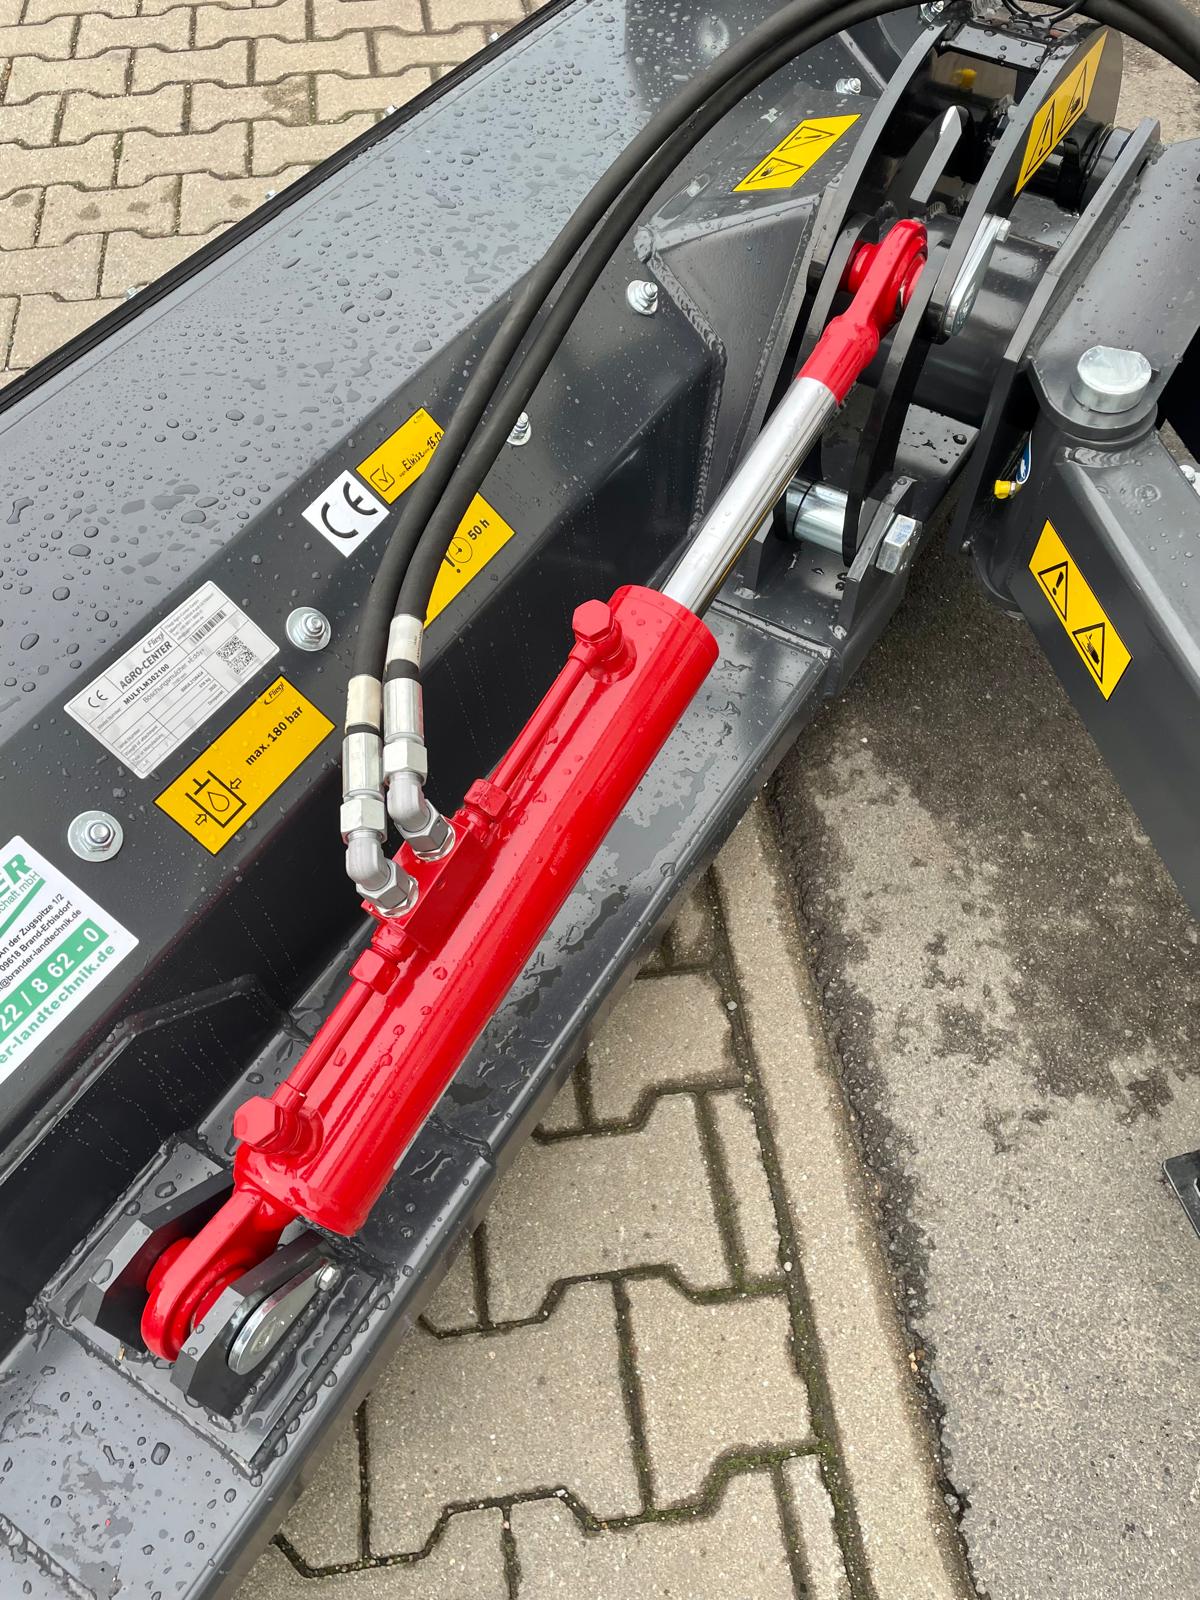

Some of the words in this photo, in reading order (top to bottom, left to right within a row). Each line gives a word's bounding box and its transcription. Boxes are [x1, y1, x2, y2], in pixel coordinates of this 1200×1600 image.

[321, 481, 378, 539] CE
[468, 525, 483, 541] 50
[479, 519, 490, 529] h
[147, 631, 165, 648] Fliegl
[119, 641, 172, 690] AGRO-CENTER
[123, 663, 170, 705] MULFLM302100
[268, 682, 285, 698] Fliegl
[88, 690, 108, 708] CE
[246, 743, 270, 766] max.
[267, 721, 287, 742] 180
[285, 706, 304, 724] bar
[0, 890, 20, 914] chaft
[18, 871, 41, 892] mbH
[0, 946, 10, 958] An
[9, 934, 21, 947] der
[20, 903, 54, 937] Zugspitze
[52, 893, 65, 905] 1/2
[0, 950, 22, 972] 09618
[19, 900, 73, 951] Brand-Erbisdorf
[0, 1003, 23, 1032] 22
[20, 990, 33, 1006] /
[31, 978, 48, 993] 8
[47, 952, 75, 978] 62
[83, 927, 100, 943] 0
[0, 943, 116, 1064] er-landtechnik.de
